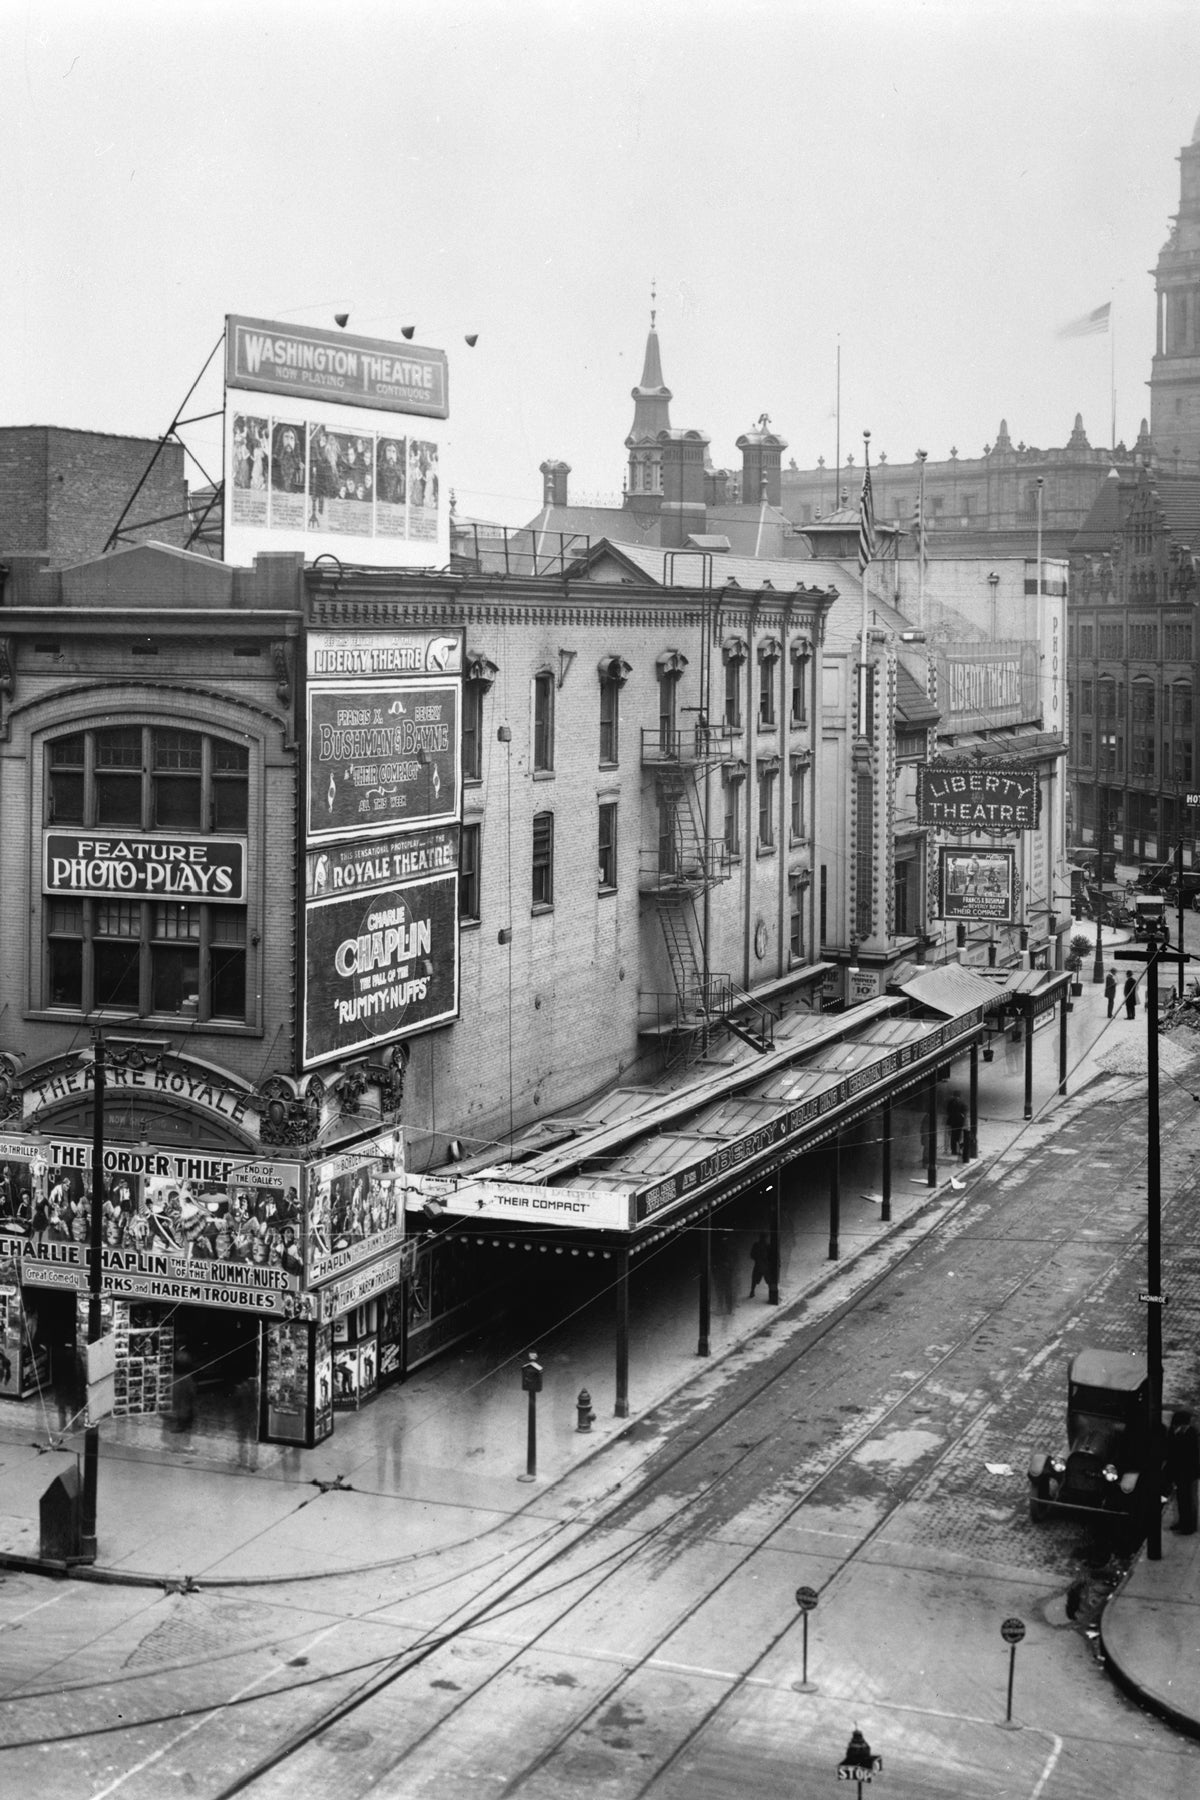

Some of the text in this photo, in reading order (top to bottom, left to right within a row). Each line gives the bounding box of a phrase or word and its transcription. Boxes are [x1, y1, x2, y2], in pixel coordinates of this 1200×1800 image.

[245, 334, 432, 391] WASHINGTON THEATRE
[276, 366, 345, 388] NOW PLAYING
[376, 383, 431, 400] CONTINUOUS
[315, 648, 421, 673] LIBERTY THEATRE
[949, 663, 983, 711] LIBERTY
[337, 709, 383, 726] FRANCIS X.
[415, 705, 442, 721] BEVERLY
[319, 723, 393, 761] BUSHMAN
[402, 719, 449, 755] BAYNE
[930, 775, 1031, 799] LIBERTY
[358, 795, 406, 812] ALL THIS WEEK
[929, 802, 1028, 821] THEATRE
[435, 834, 445, 844] THE
[78, 841, 207, 862] FEATURE
[52, 858, 233, 893] PHOTO-PLAYS
[333, 857, 390, 888] ROYALE
[367, 906, 405, 931] CHARLIE
[335, 918, 431, 977] CHAPLIN
[360, 965, 409, 991] THE FALL OF THE
[155, 1070, 249, 1124] ROYALE
[9, 1145, 39, 1157] THRILLER
[700, 1121, 777, 1182] LIBERTY
[51, 1145, 233, 1182] THE ORDER THIEF
[244, 1166, 274, 1176] END OF
[235, 1174, 283, 1186] THE GALLEYS
[0, 1239, 79, 1264] CHARLIE
[171, 1258, 208, 1271] THE FALL
[176, 1269, 206, 1279] OF THE
[211, 1263, 289, 1290] RUMMY-NUFFS
[26, 1268, 274, 1308] Great Comedy TRKS and HAREM TROUBLES
[839, 1766, 871, 1781] STOP
